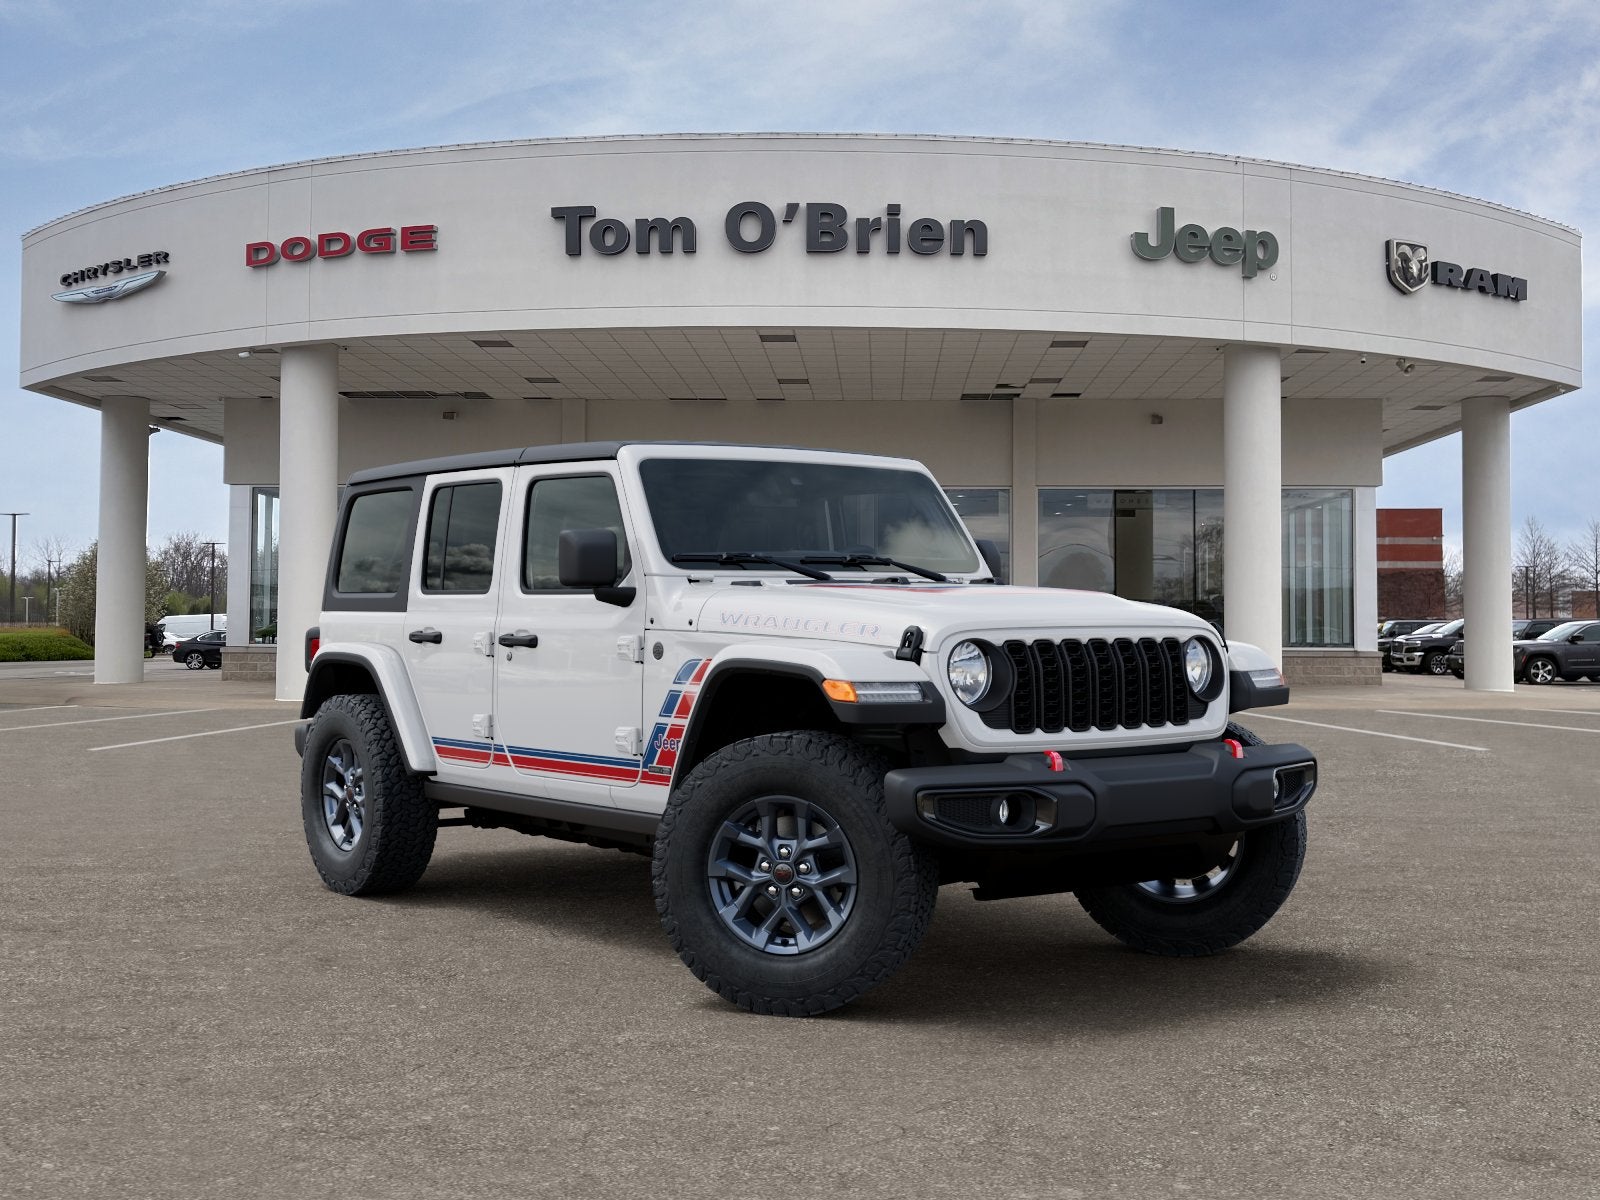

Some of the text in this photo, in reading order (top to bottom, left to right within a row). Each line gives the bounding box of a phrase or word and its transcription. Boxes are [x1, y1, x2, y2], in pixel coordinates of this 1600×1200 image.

[246, 224, 437, 267] DODGE
[550, 201, 989, 256] Tom O'Brien
[1130, 207, 1279, 279] Jeep
[59, 250, 170, 288] CHRYSLER
[1431, 261, 1528, 302] RAM
[721, 611, 880, 639] WRANGLER
